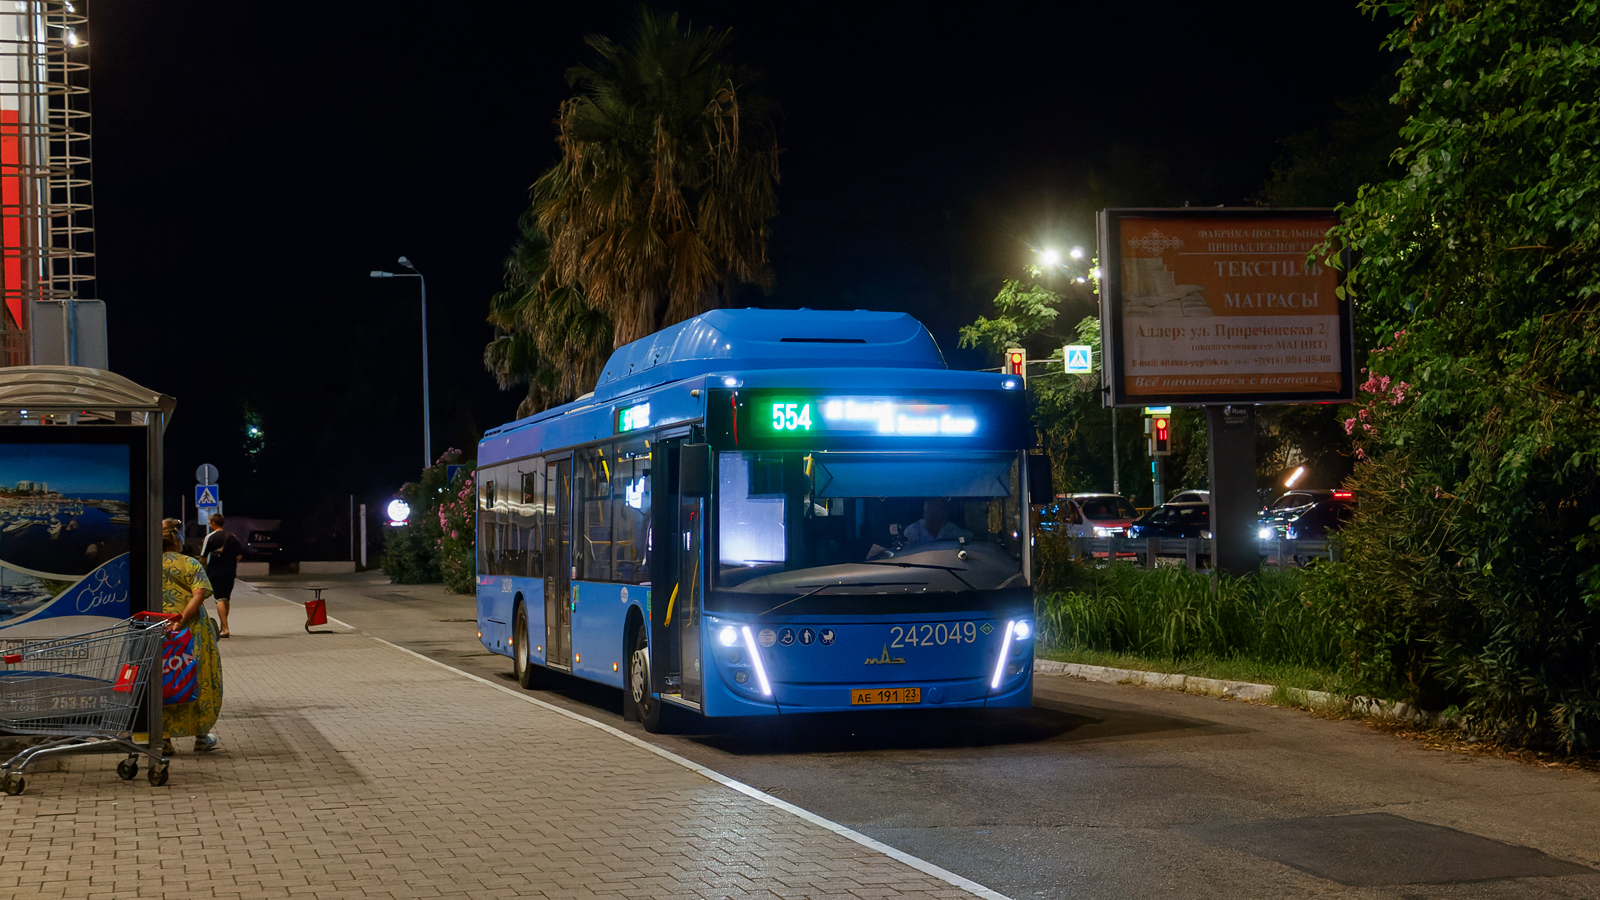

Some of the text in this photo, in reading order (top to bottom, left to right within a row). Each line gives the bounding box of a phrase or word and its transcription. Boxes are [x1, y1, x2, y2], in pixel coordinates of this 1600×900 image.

[1199, 229, 1249, 239] ФАБРИКА
[1214, 261, 1323, 277] ТЕКСТИЛЬ
[1224, 292, 1319, 308] МАТРАСЫ
[1135, 324, 1185, 340] Адлер:
[1215, 324, 1313, 340] Приреченская
[1135, 377, 1160, 387] Всё
[1163, 377, 1245, 387] начинается
[1260, 376, 1318, 385] постели
[772, 403, 812, 431] 554
[890, 622, 977, 648] 242049
[857, 689, 917, 703] AE 191 23
